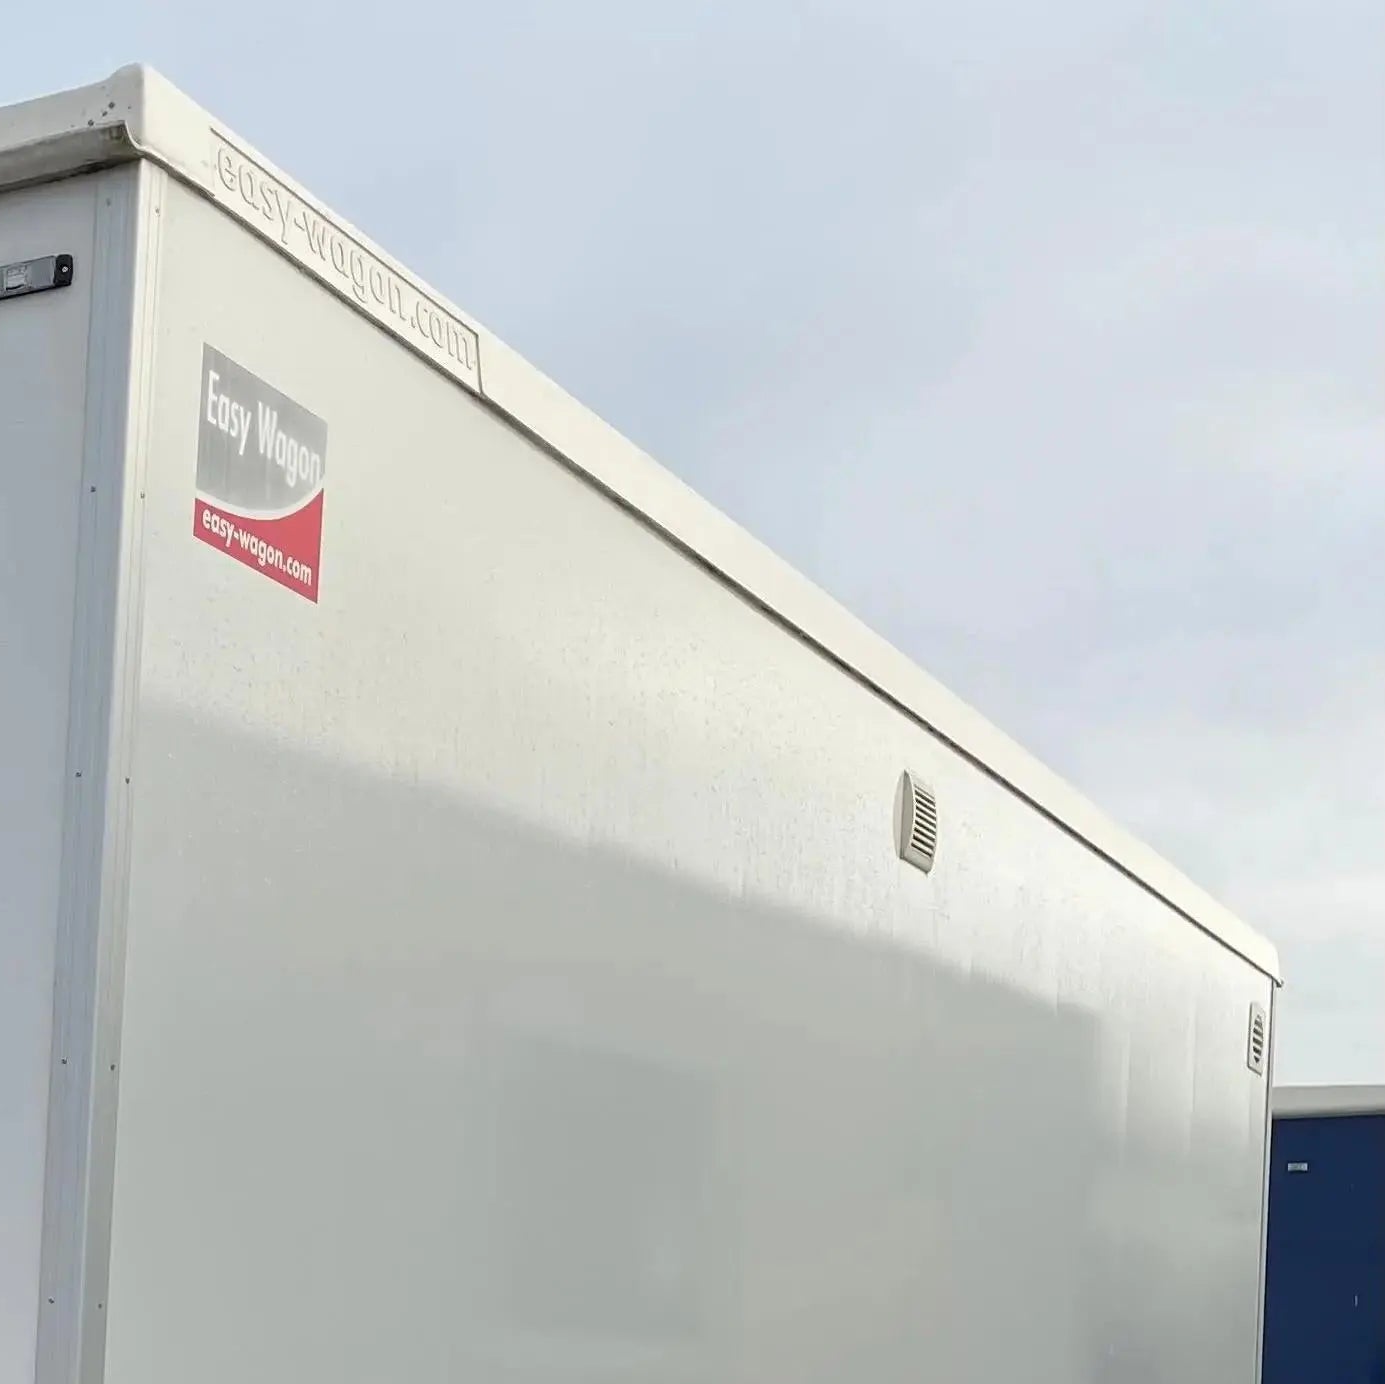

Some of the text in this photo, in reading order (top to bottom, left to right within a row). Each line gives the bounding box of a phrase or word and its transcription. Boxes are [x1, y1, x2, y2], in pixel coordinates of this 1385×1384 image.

[217, 146, 473, 370] easy-wagon.com
[207, 369, 321, 488] Easy Wagon
[202, 508, 313, 586] easy-wagon.com
